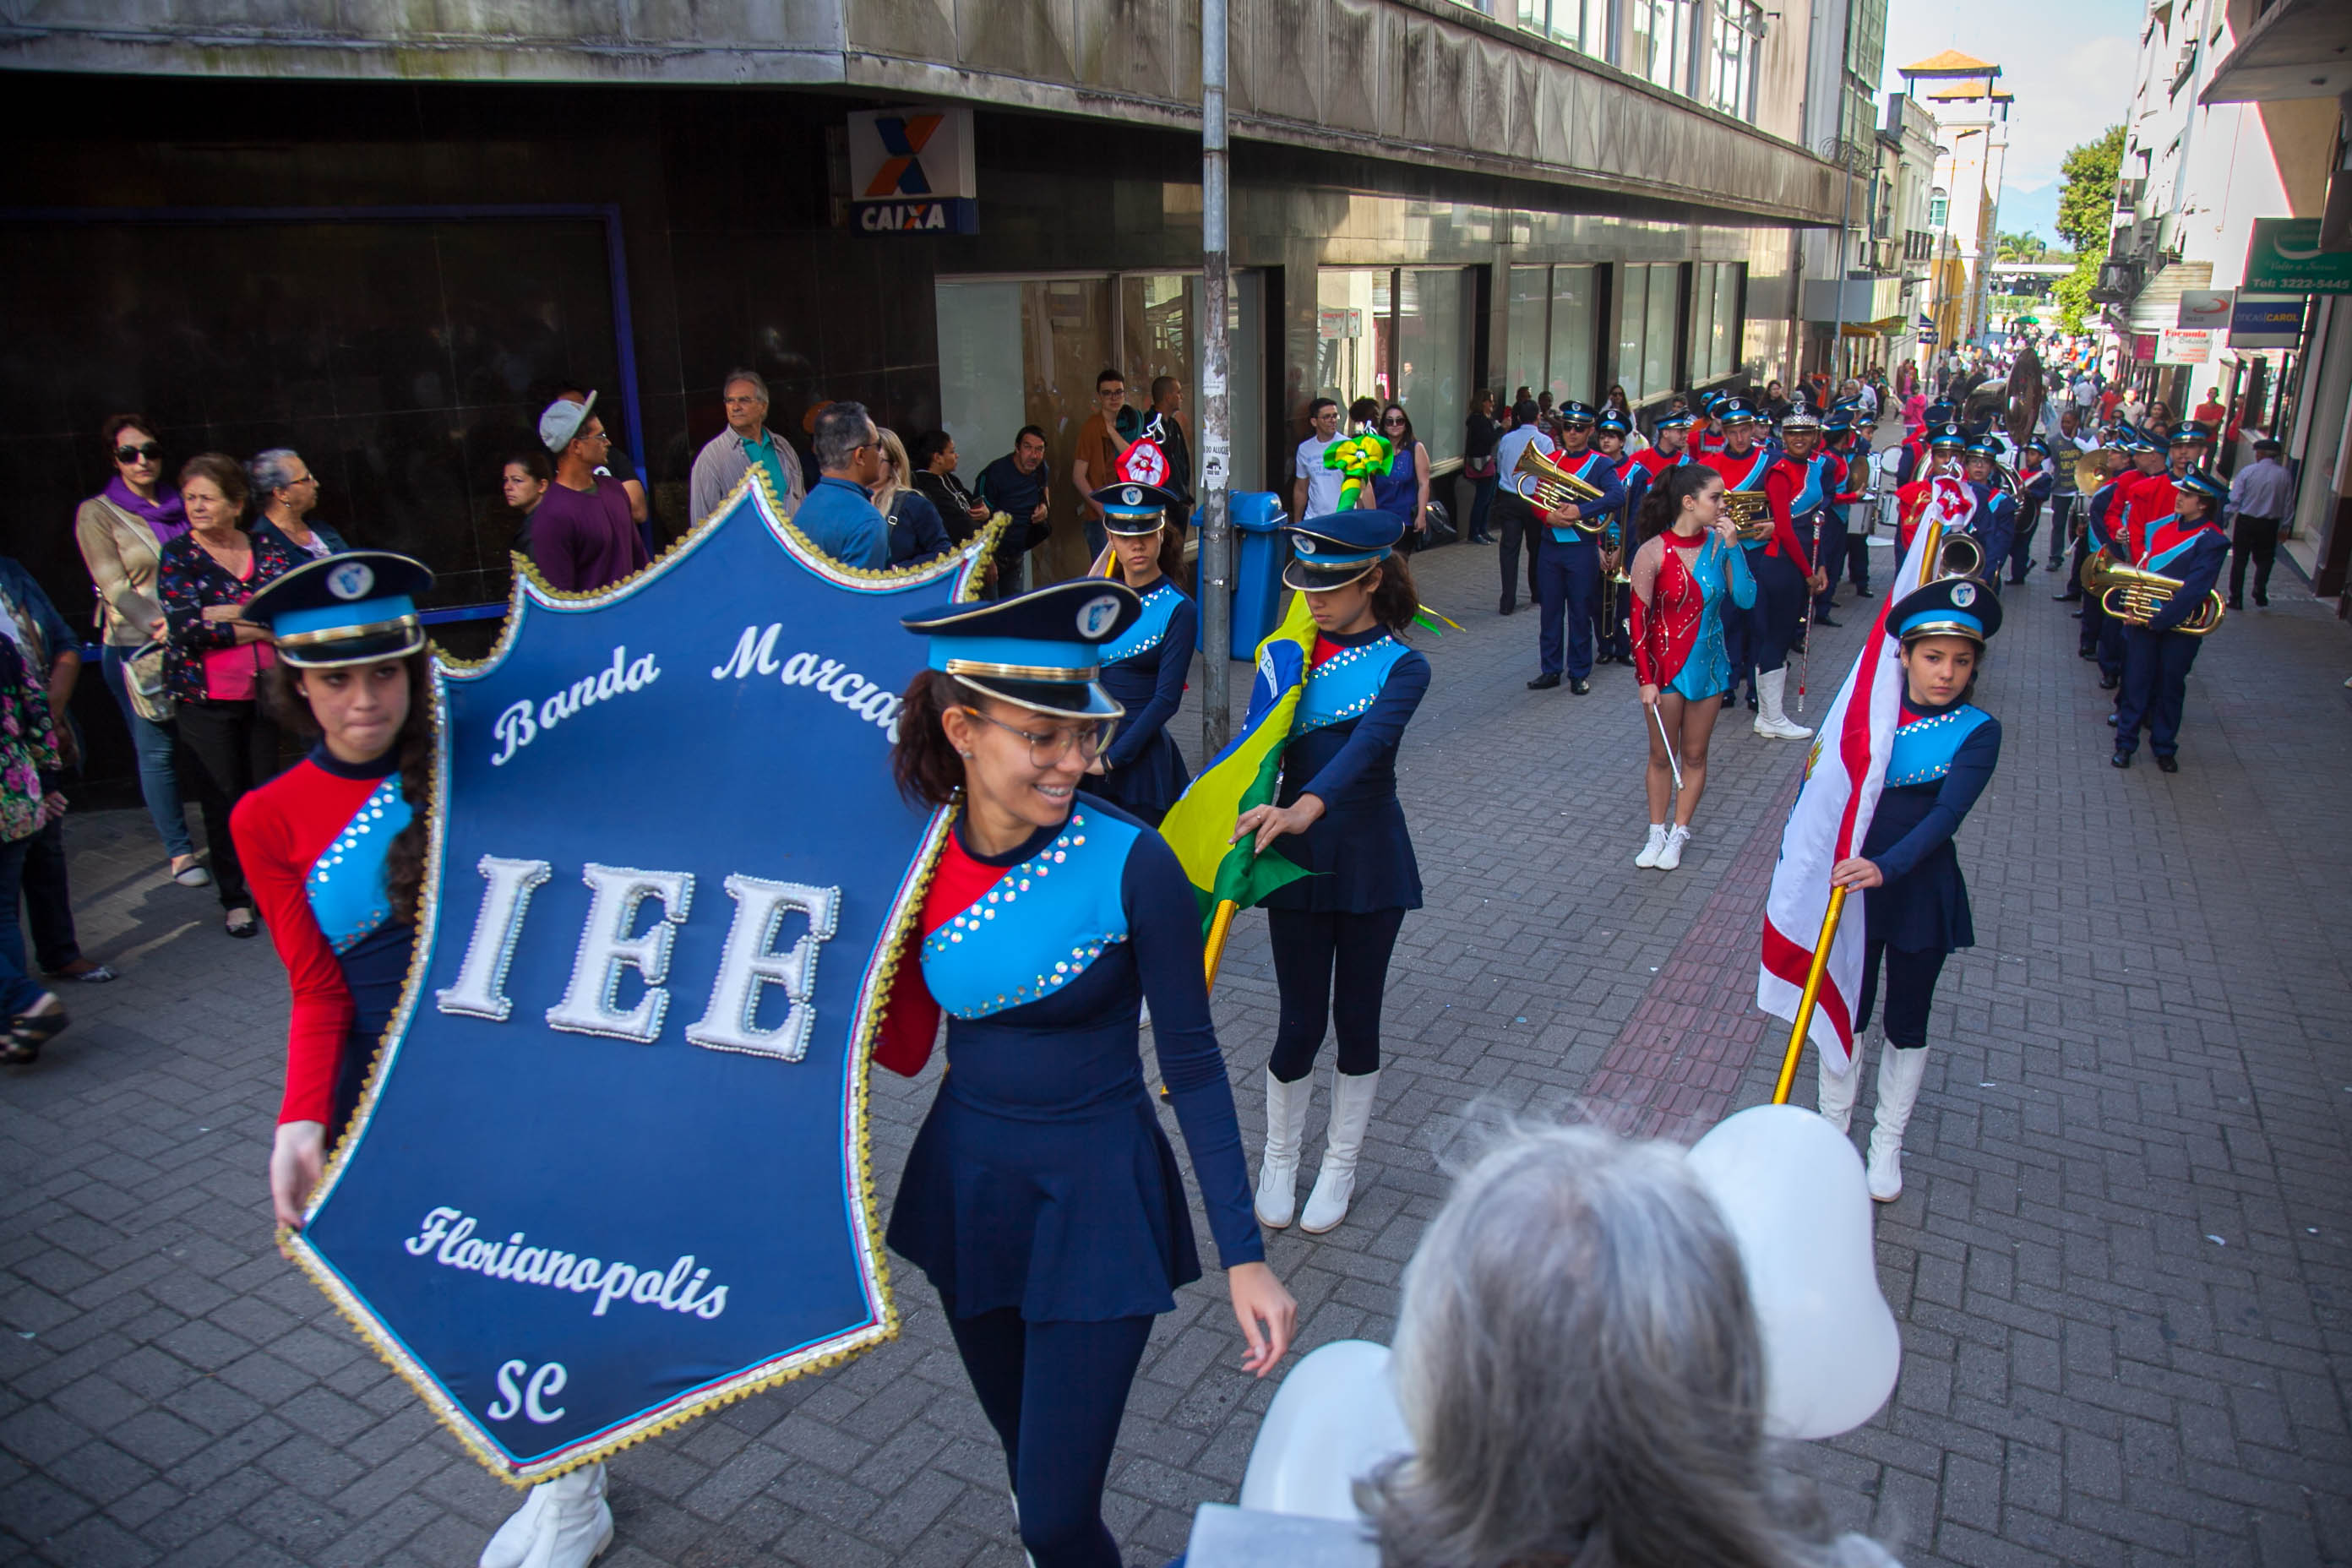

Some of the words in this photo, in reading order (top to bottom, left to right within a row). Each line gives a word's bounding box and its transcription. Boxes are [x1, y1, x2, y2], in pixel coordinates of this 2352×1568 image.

[861, 204, 946, 231] CAIXA
[2266, 313, 2299, 323] CAROL
[491, 645, 662, 767] Banda
[436, 853, 842, 1063] IEE
[405, 1206, 729, 1320] Florianopolis
[487, 1358, 568, 1424] SC
